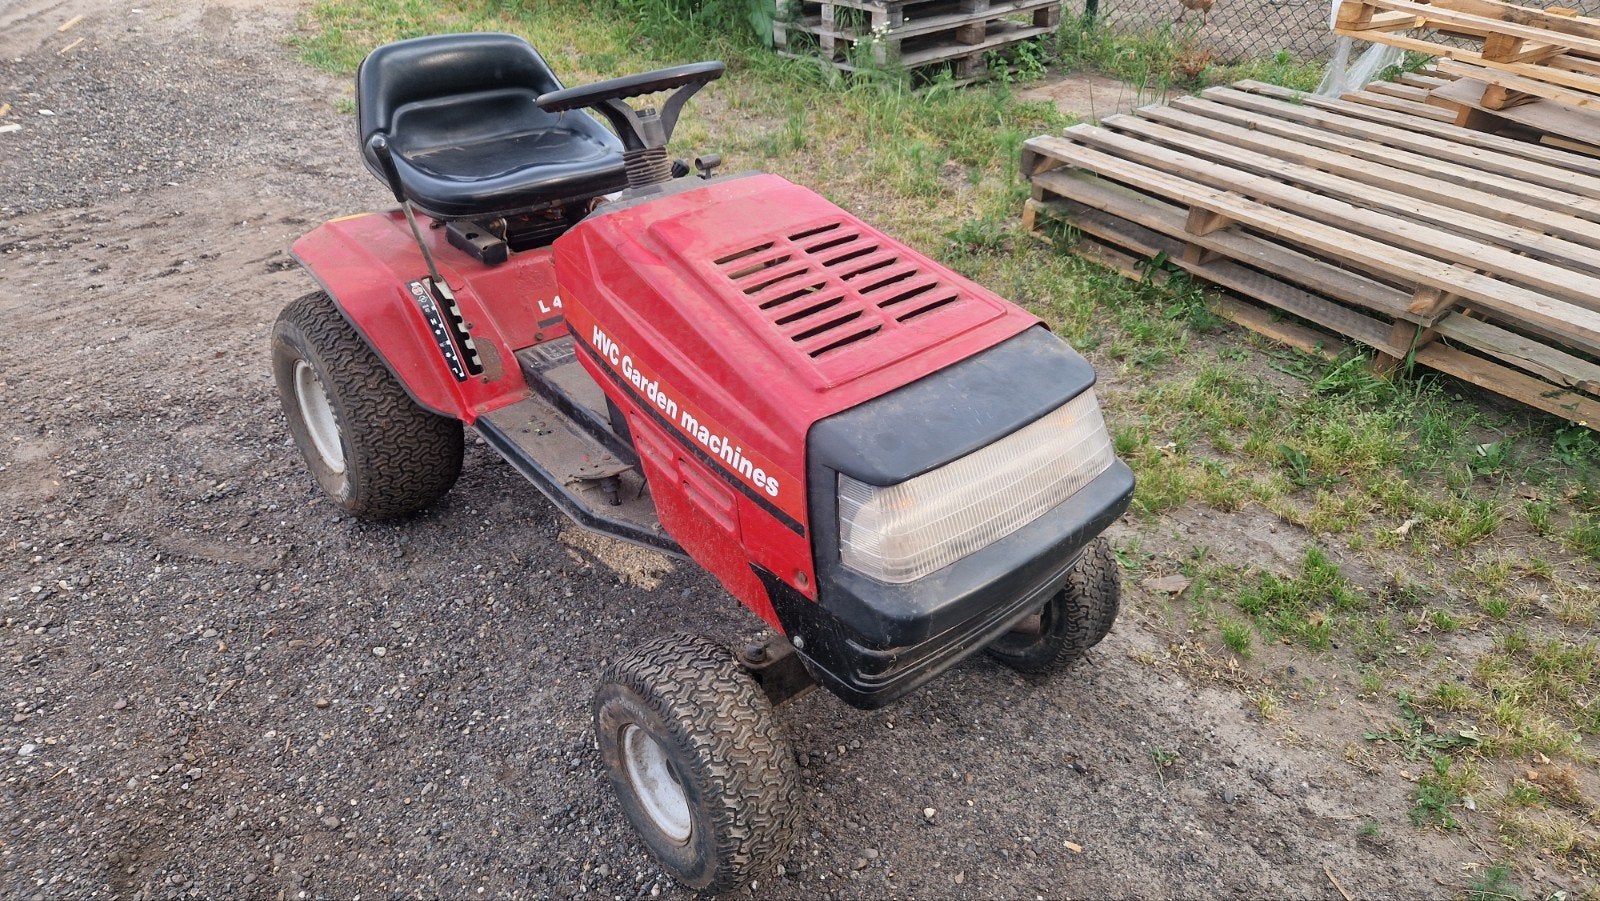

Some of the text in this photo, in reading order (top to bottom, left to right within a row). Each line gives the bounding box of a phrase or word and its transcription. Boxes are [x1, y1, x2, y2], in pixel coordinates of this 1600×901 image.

[538, 295, 563, 313] L 4
[592, 325, 780, 497] HVC Garden machines
